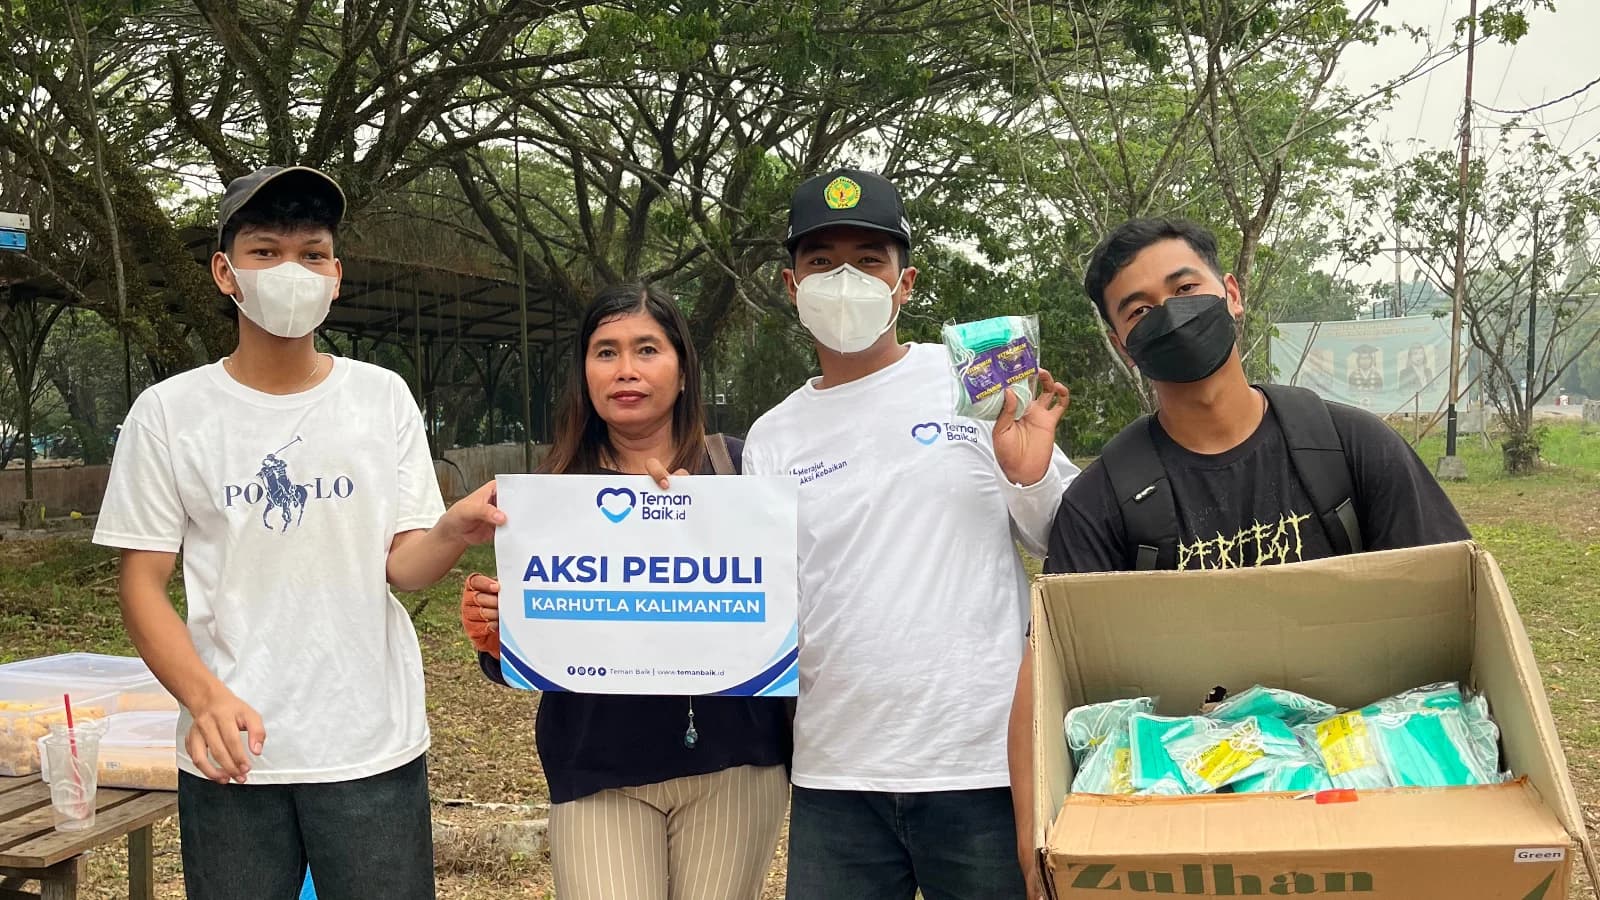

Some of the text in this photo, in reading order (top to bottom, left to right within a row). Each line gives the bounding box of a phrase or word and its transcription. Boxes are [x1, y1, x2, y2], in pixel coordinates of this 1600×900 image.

[799, 460, 848, 486] Aksi Kebaikan
[639, 491, 692, 506] Teman
[642, 506, 686, 521] Baik.id
[523, 555, 763, 584] AKSI PEDULI
[531, 596, 760, 614] KARHUTLA KALIMANTAN
[1518, 851, 1561, 859] Green
[1067, 863, 1376, 895] Zulhan
